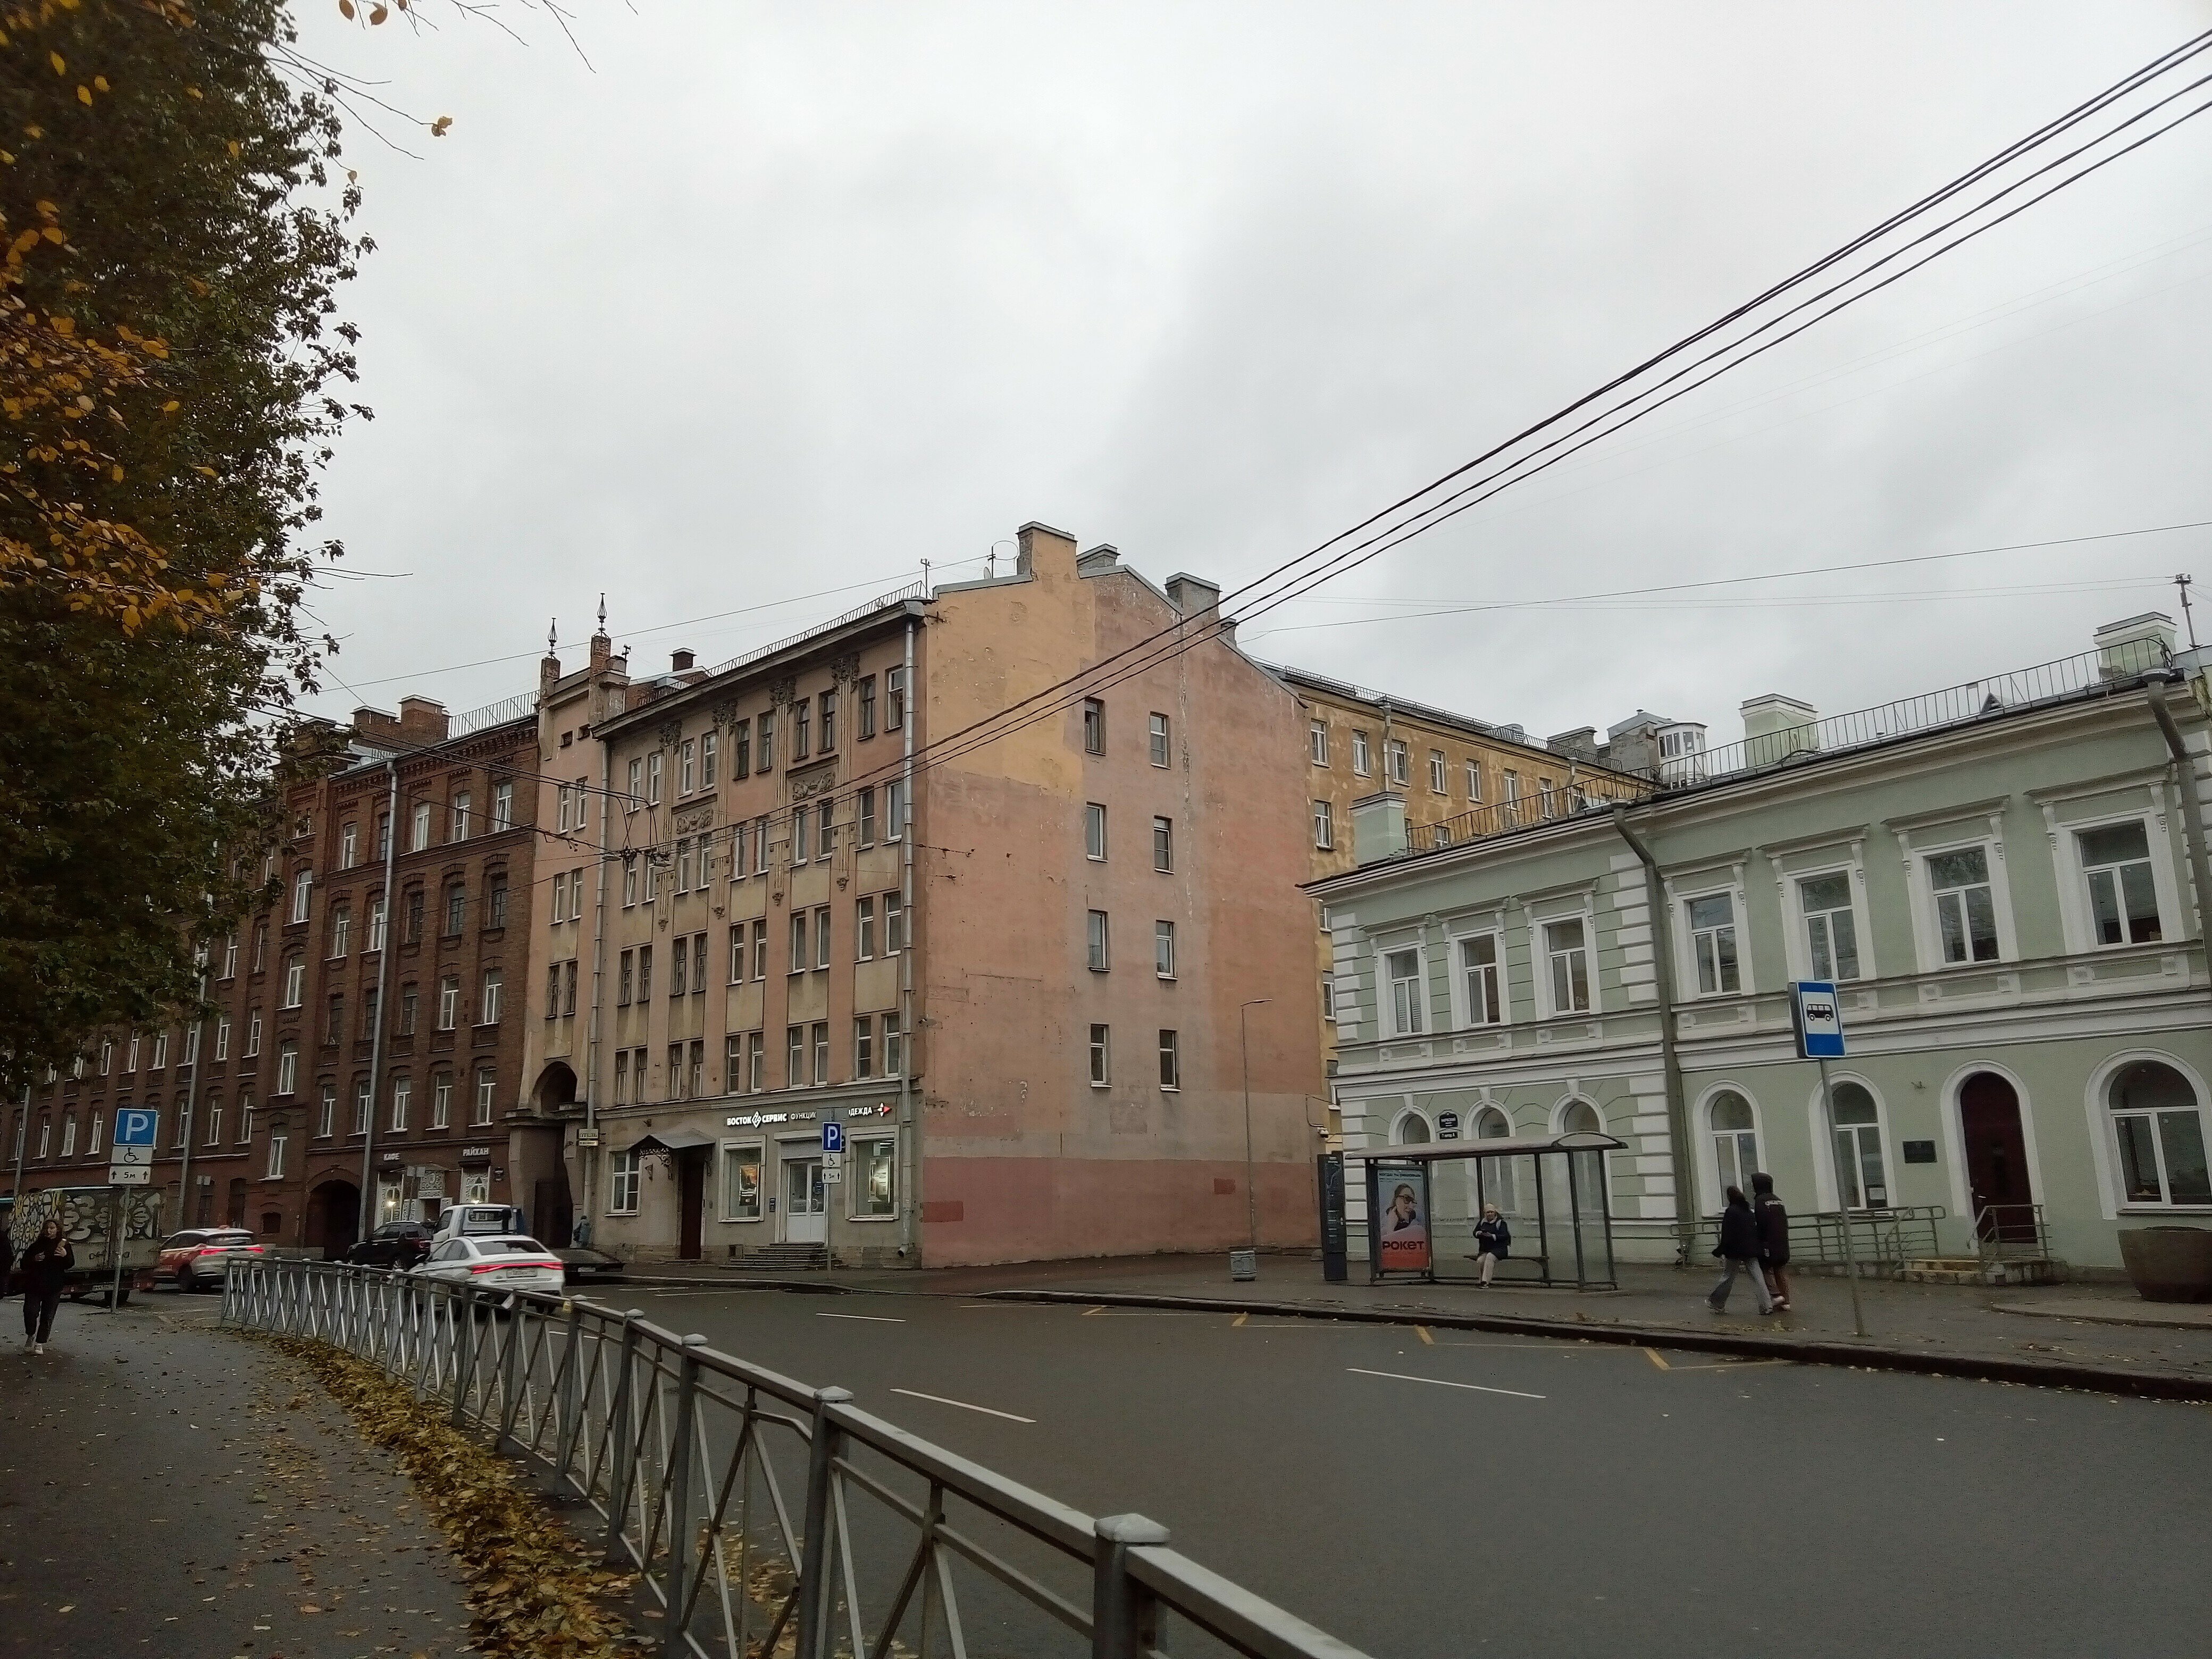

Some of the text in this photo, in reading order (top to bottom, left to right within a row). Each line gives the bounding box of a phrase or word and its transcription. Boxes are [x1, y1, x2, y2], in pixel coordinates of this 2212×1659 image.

[125, 1113, 148, 1141] P
[727, 1116, 752, 1126] ВОСТОК
[761, 1113, 787, 1123] СЕРВИС
[827, 1126, 838, 1148] P
